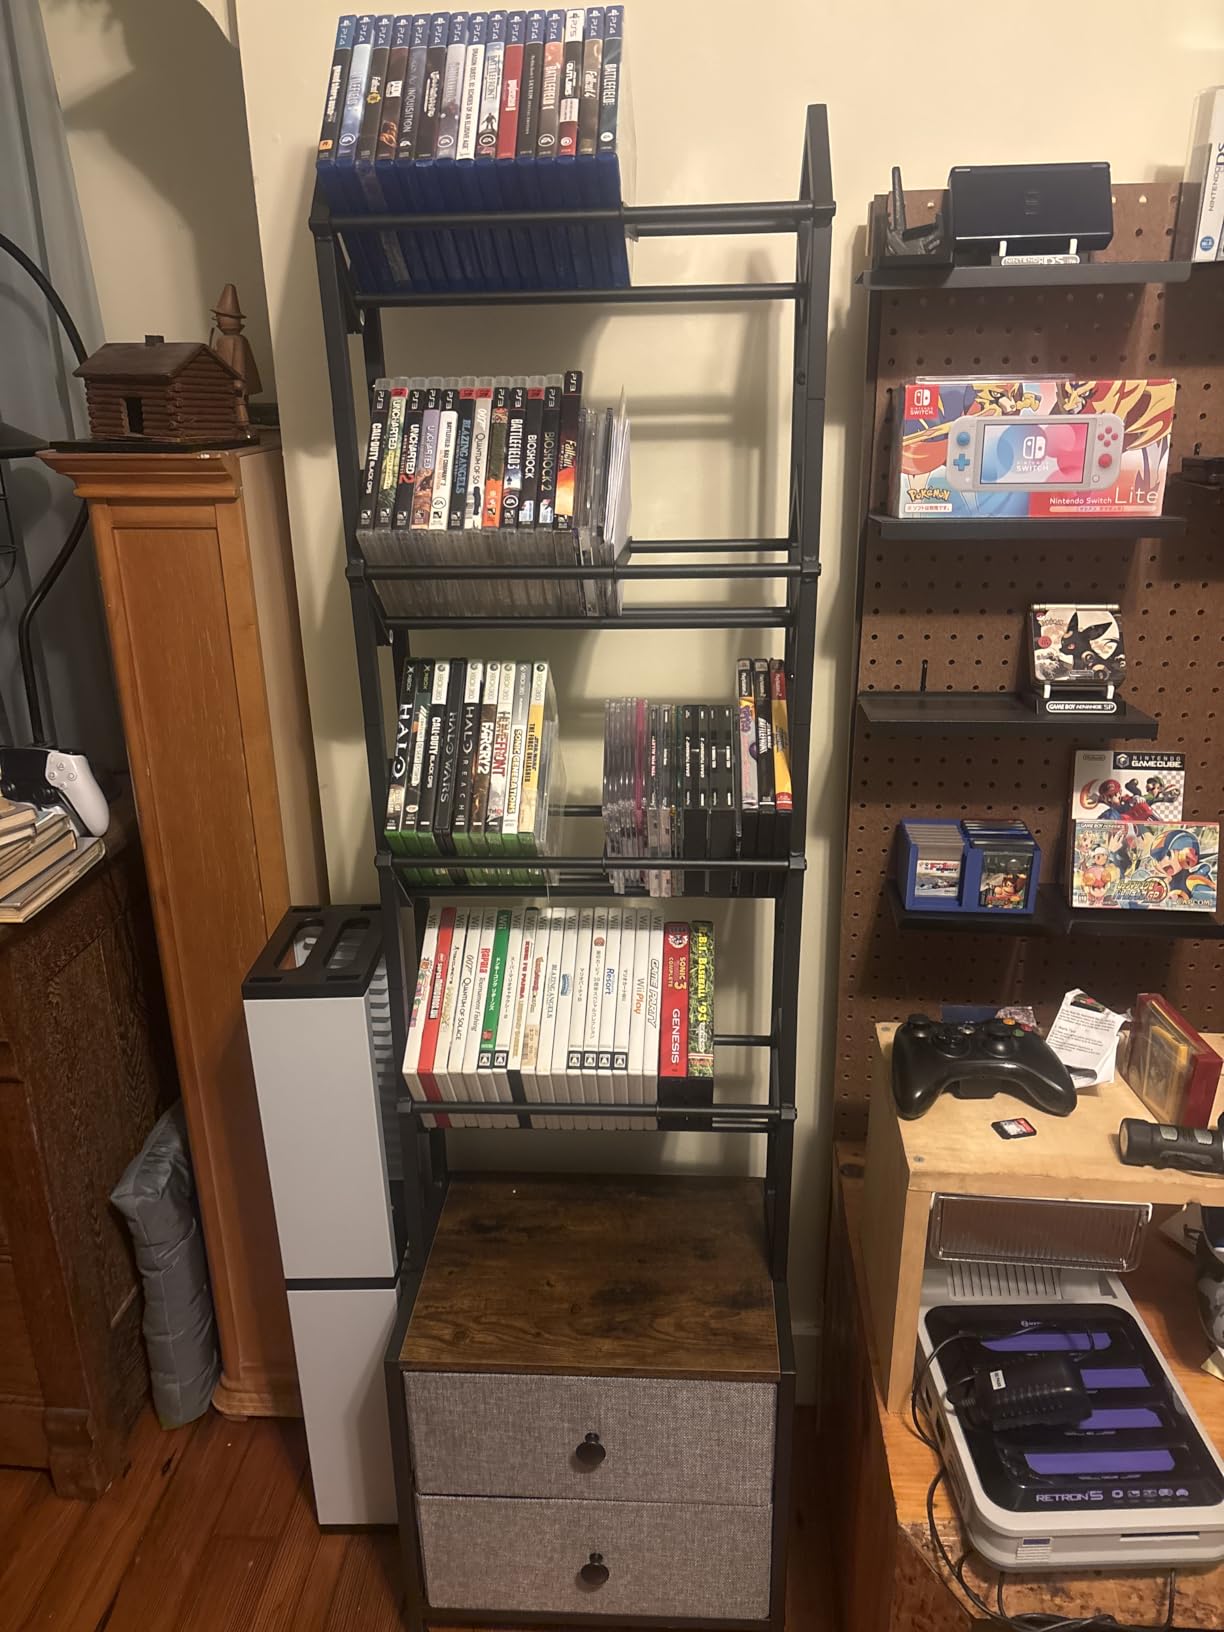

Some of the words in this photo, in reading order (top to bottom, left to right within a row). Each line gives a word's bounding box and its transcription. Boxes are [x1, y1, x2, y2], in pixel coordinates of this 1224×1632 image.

[340, 28, 348, 44] PS4
[359, 24, 368, 42] PS4
[378, 27, 386, 44] PS4
[396, 27, 405, 44] PS4
[415, 27, 423, 44] PS4
[434, 26, 442, 43] PS4
[454, 24, 462, 41] PS4
[492, 22, 500, 40] PS4
[570, 19, 578, 36] PS5
[590, 18, 598, 36] PS4
[488, 56, 497, 100] BATTLEFRONT
[543, 66, 556, 105] BATTLEFIELD
[585, 70, 598, 91] Fallout
[603, 64, 616, 104] BATTLEFIELD
[467, 88, 475, 106] ECHOES
[402, 88, 415, 132] INQUISITION
[1208, 166, 1221, 212] NINTENDO
[412, 392, 420, 410] PS3
[428, 390, 436, 408] PS3
[446, 391, 454, 409] PS3
[372, 423, 382, 440] CALL
[388, 400, 400, 449] UNCHARTED
[424, 426, 436, 468] UNCHARTED
[459, 420, 471, 457] BLAZING
[508, 418, 522, 464] BATTLEFIELD
[368, 441, 380, 461] DUTY
[406, 424, 420, 474] UNCHARTED
[474, 433, 486, 465] QUANTUM
[525, 435, 537, 479] BIOSHOCK
[542, 432, 555, 482] BIOSHOCK
[564, 440, 576, 468] Fallout
[400, 474, 414, 484] 2
[456, 458, 468, 494] ANGELS
[541, 482, 552, 491] 2
[1050, 497, 1084, 505] Nintendo
[1086, 496, 1112, 504] Switch
[1114, 486, 1158, 504] Lite
[432, 717, 441, 734] CALL
[446, 712, 457, 754] HALO
[463, 706, 474, 754] HALO
[392, 704, 412, 778] HALO
[429, 736, 438, 754] DUTY
[493, 711, 511, 777] HOMEFRONT
[512, 728, 522, 754] SONIC
[414, 742, 424, 764] DESERT
[441, 759, 453, 802] WARS
[458, 760, 468, 810] REACH
[507, 756, 520, 814] GENERATIONS
[428, 914, 437, 928] Wii
[456, 914, 464, 928] Wii
[470, 915, 480, 930] Wii
[485, 915, 494, 930] Wii
[498, 914, 508, 929] Wii
[512, 915, 521, 929] Wii
[526, 916, 534, 930] Wii
[538, 916, 547, 930] Wii
[553, 917, 562, 931] Wii
[568, 915, 576, 930] Wii
[582, 916, 590, 930] Wii
[596, 916, 605, 929] Wii
[610, 916, 618, 929] Wii
[625, 915, 633, 930] Wii
[639, 916, 647, 930] Wii
[653, 916, 662, 930] Wii
[605, 968, 614, 994] Resort
[650, 959, 659, 988] GAME
[460, 978, 472, 1008] QUANTUM
[474, 977, 485, 1010] Tournament
[674, 981, 686, 990] 3
[648, 989, 658, 1028] PARTY
[698, 1001, 707, 1022] '93
[456, 1017, 464, 1040] SOLACE
[471, 1011, 481, 1032] Fishing
[671, 1008, 680, 1064] GENESIS
